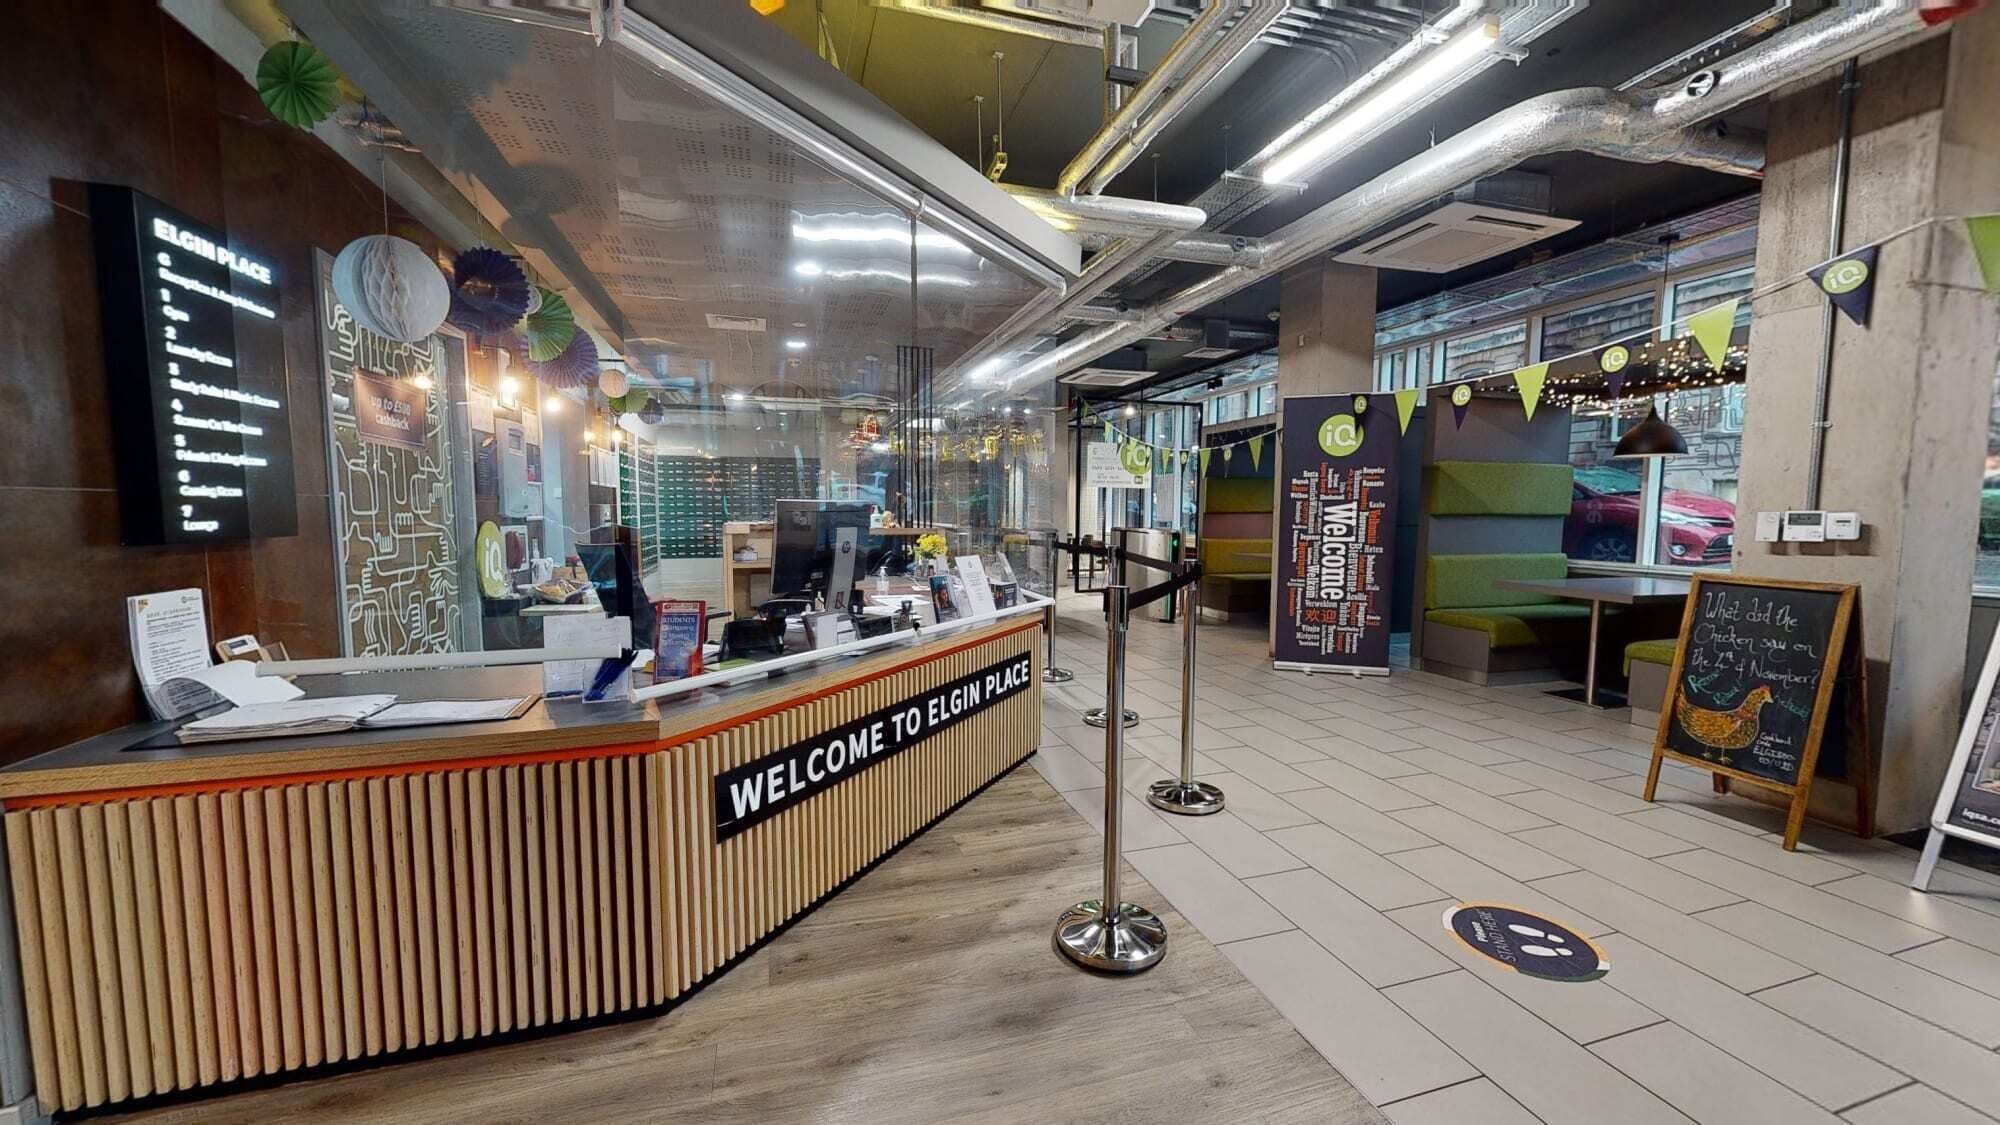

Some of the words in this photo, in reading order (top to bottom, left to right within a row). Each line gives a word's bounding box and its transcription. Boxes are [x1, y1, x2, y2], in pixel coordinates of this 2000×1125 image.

[154, 218, 216, 260] ELGIN
[217, 247, 271, 284] PLACE
[1829, 266, 1861, 289] iQ
[160, 289, 170, 302] 1
[165, 326, 177, 340] 2
[171, 398, 183, 412] 4
[174, 434, 186, 447] 5
[1325, 424, 1357, 447] iQ
[177, 470, 190, 482] 6
[181, 504, 193, 517] 7
[485, 537, 504, 582] iQ
[1320, 501, 1358, 600] Welcome
[1347, 543, 1362, 592] Bienvenue
[1306, 564, 1320, 599] Welkom
[1305, 608, 1337, 624] 欢迎
[1704, 591, 1741, 625] What
[1746, 597, 1774, 625] did
[1693, 622, 1758, 655] Chicken
[1792, 643, 1817, 659] on
[1749, 654, 1821, 690] November?
[730, 721, 884, 820] WELCOME
[892, 708, 921, 742] TO
[928, 680, 981, 727] ELGIN
[986, 659, 1030, 700] PLACE
[1479, 911, 1498, 932] HERE
[1488, 932, 1517, 962] STAND
